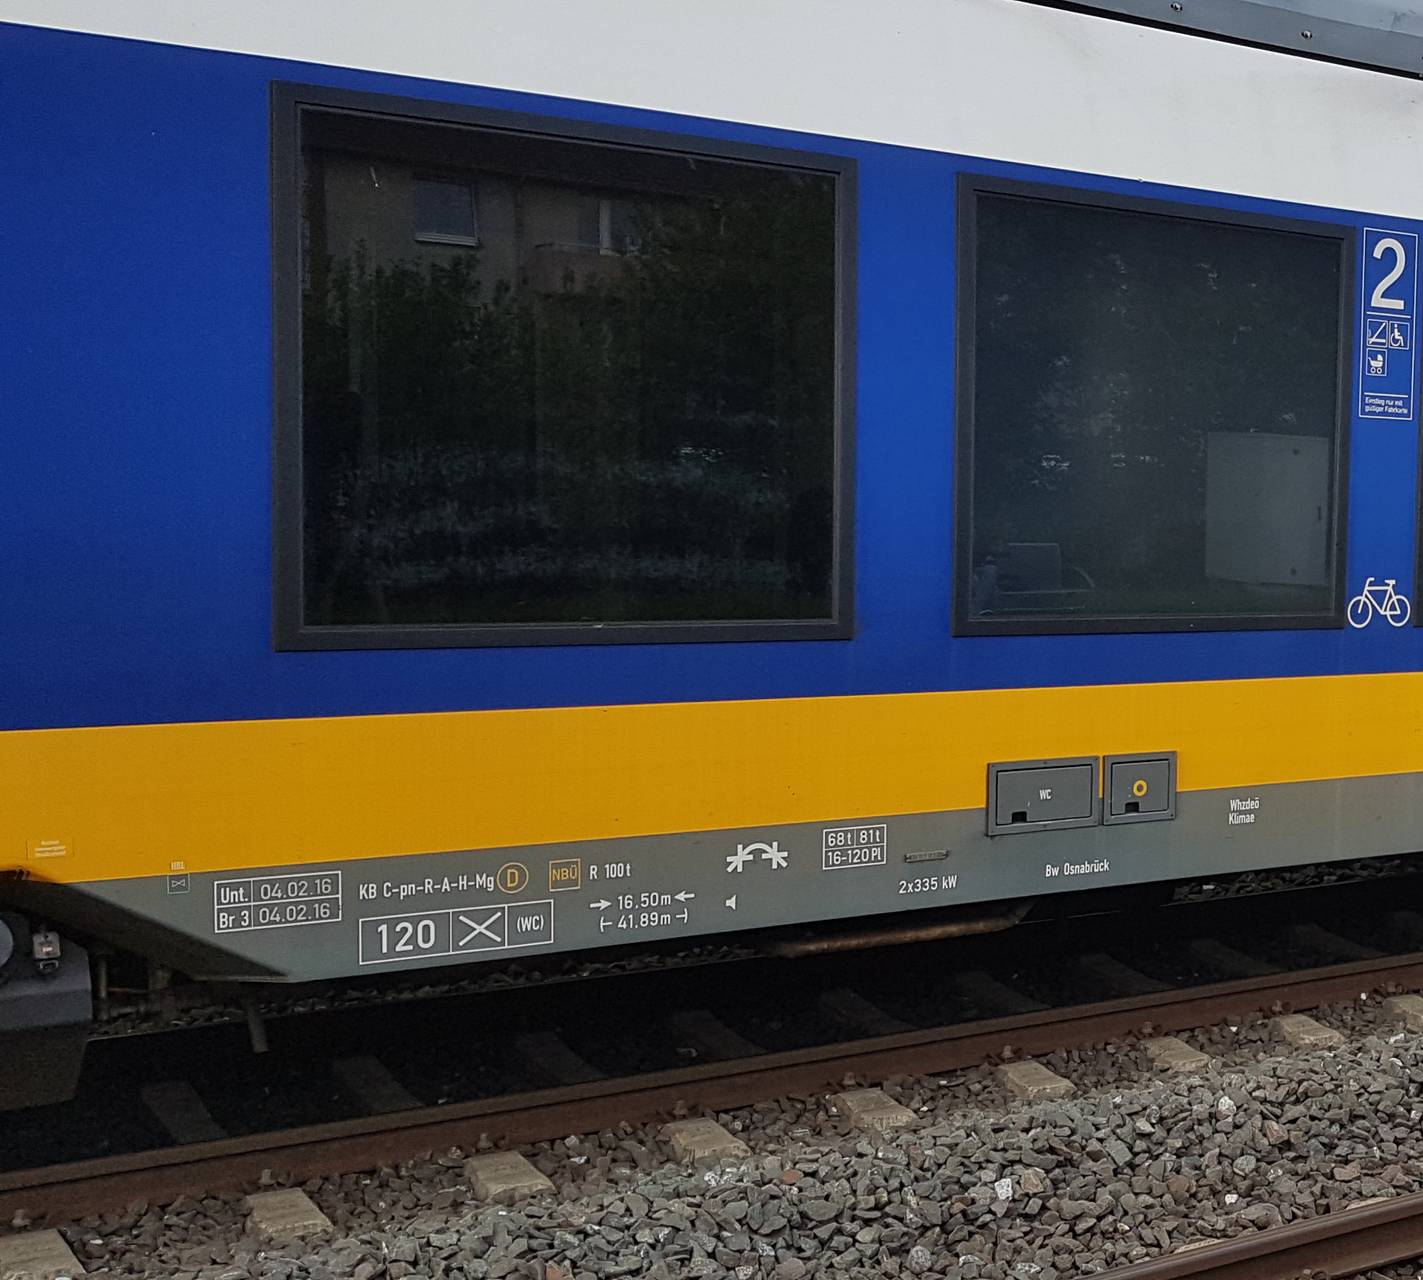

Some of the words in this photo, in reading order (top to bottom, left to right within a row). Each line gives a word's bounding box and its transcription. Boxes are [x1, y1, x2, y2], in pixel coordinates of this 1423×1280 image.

[1370, 237, 1406, 310] 2
[1039, 788, 1052, 800] WC
[552, 864, 578, 881] NBÜ
[589, 865, 598, 880] R
[1045, 864, 1060, 877] Bw
[1063, 858, 1110, 876] Osnabrück
[220, 887, 249, 904] Unt.
[260, 878, 332, 901] 04.02.16
[359, 883, 377, 900] KB
[383, 872, 495, 900] C-pn-R-A-H-Mg
[898, 876, 938, 894] 2x335
[942, 874, 958, 890] kW
[219, 912, 236, 929] Br
[240, 910, 249, 926] 3
[259, 902, 330, 924] 04.02.16
[516, 914, 544, 933] (WC)
[377, 919, 436, 954] 120
